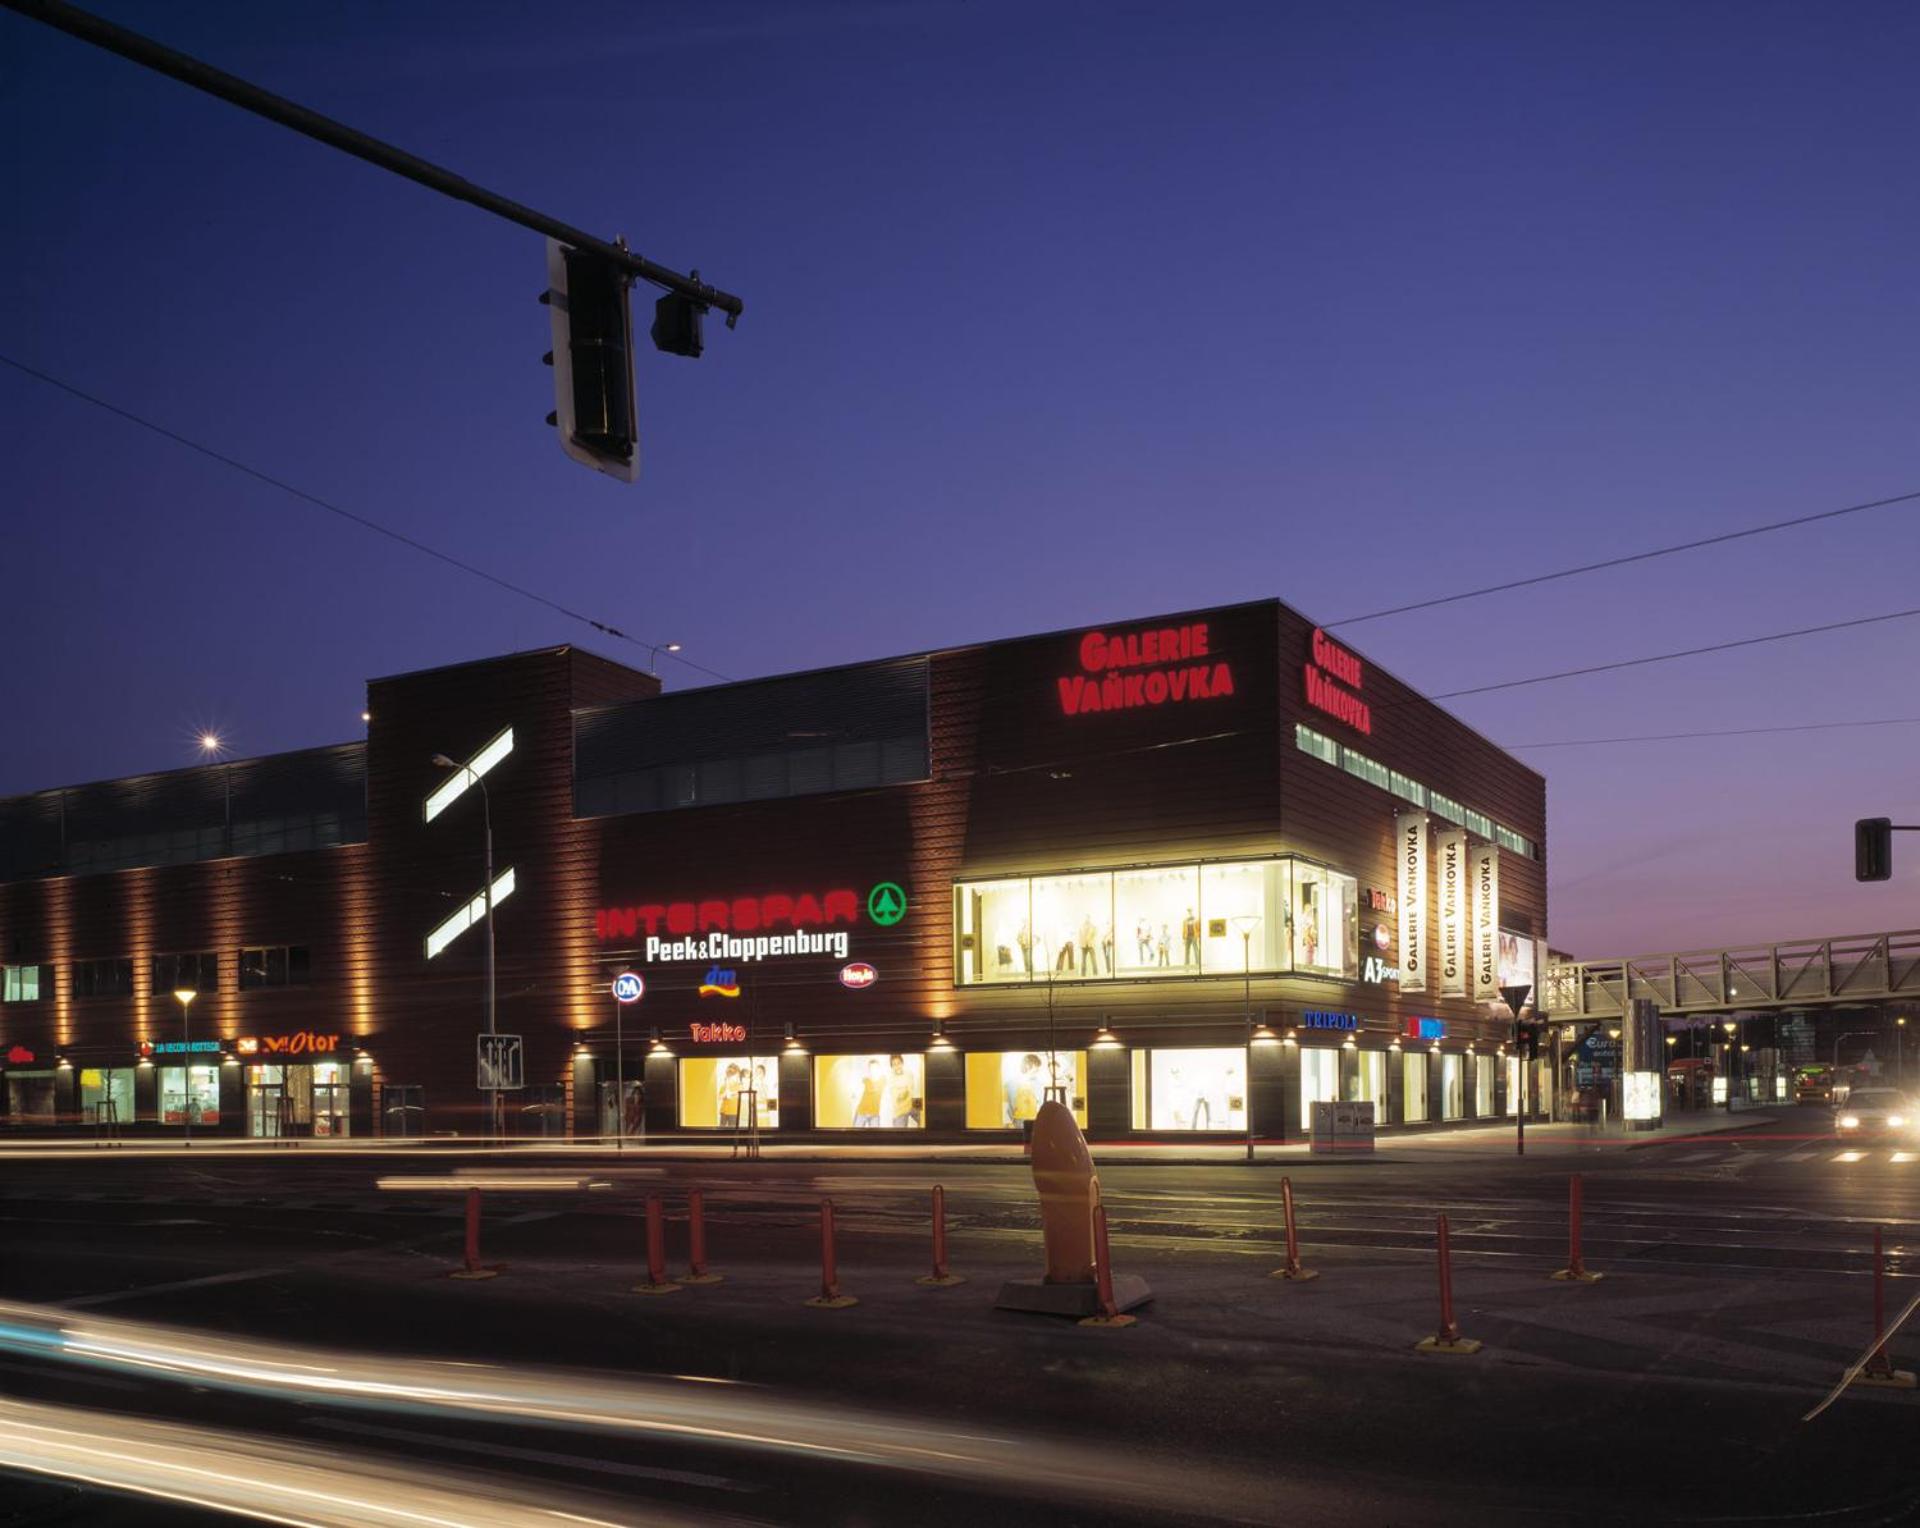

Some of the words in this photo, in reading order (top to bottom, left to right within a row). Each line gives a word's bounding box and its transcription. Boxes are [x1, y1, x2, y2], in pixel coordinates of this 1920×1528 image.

[1079, 623, 1209, 671] GALERIE
[1311, 627, 1362, 690] GALERIE
[1057, 662, 1234, 716] VAŇKOVKA
[1304, 664, 1371, 736] VAŇKOVKA
[594, 889, 859, 940] INTERSPAR
[646, 929, 849, 962] Peek&Cloppenburg
[1407, 911, 1418, 973] GALERIE
[1444, 919, 1456, 979] GALERIE
[1480, 929, 1492, 985] GALERIE
[704, 964, 736, 985] dm
[690, 1023, 746, 1042] Takko
